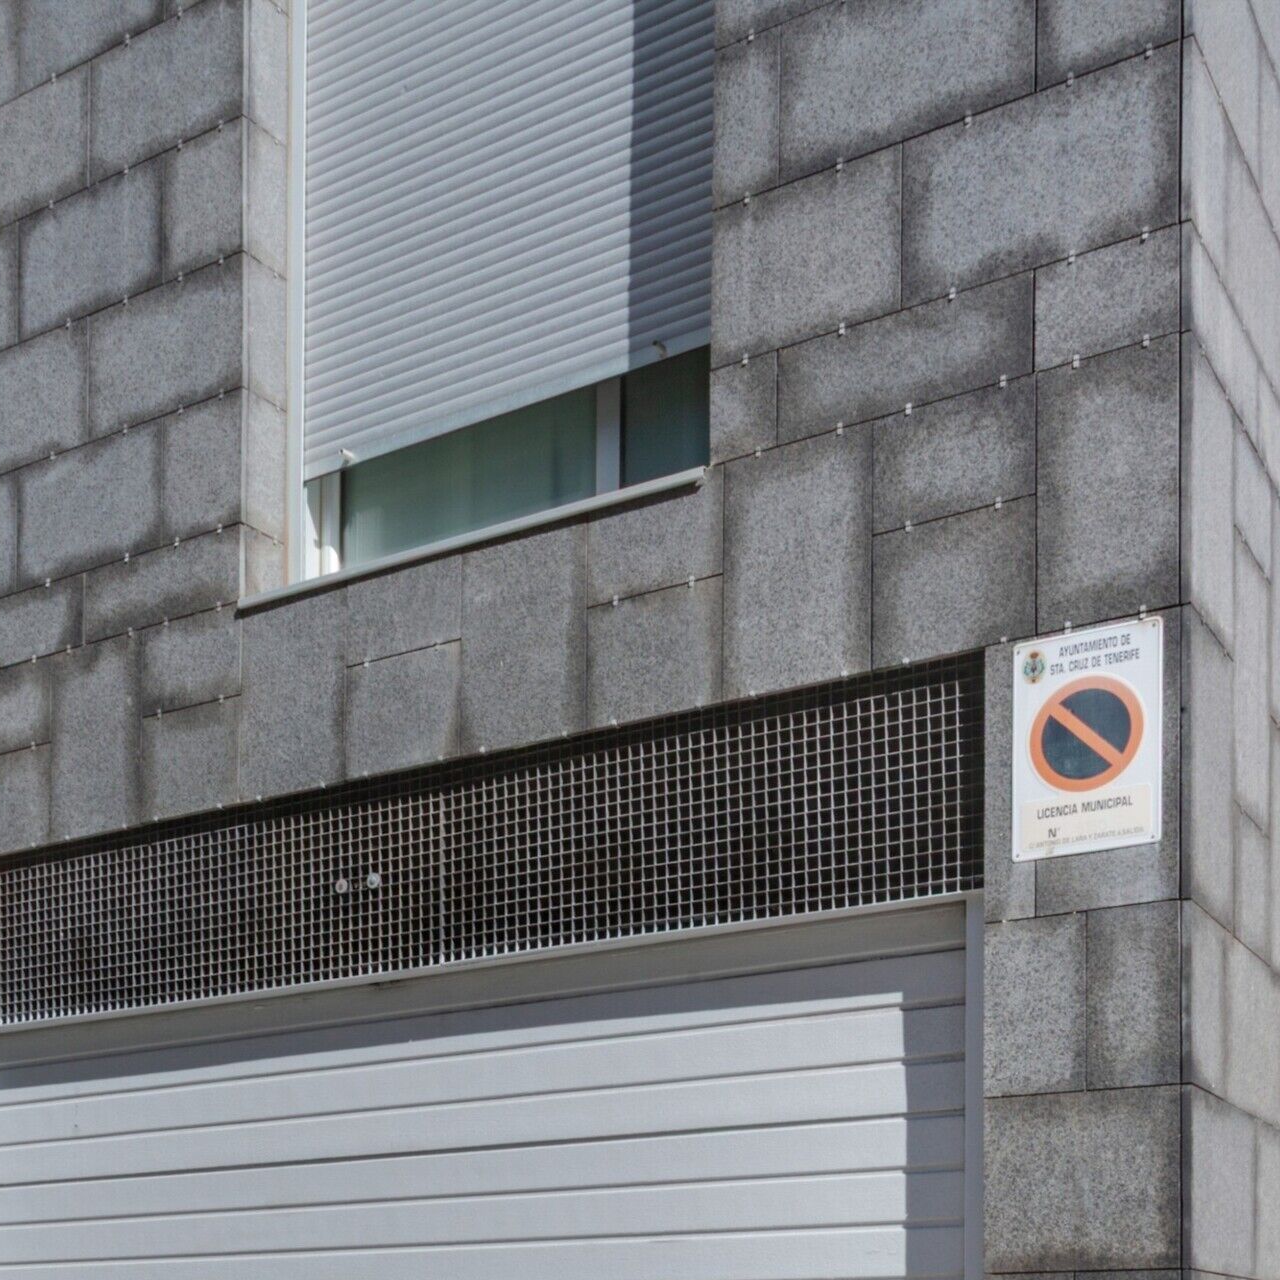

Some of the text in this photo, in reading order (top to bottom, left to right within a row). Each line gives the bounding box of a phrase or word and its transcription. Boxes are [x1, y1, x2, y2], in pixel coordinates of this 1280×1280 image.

[1059, 633, 1131, 657] AYUNTAMIENTO DE
[1050, 648, 1140, 675] STA. CRUZ DE TENERIFE
[1037, 795, 1133, 820] LICENCIA MUNICIPAL
